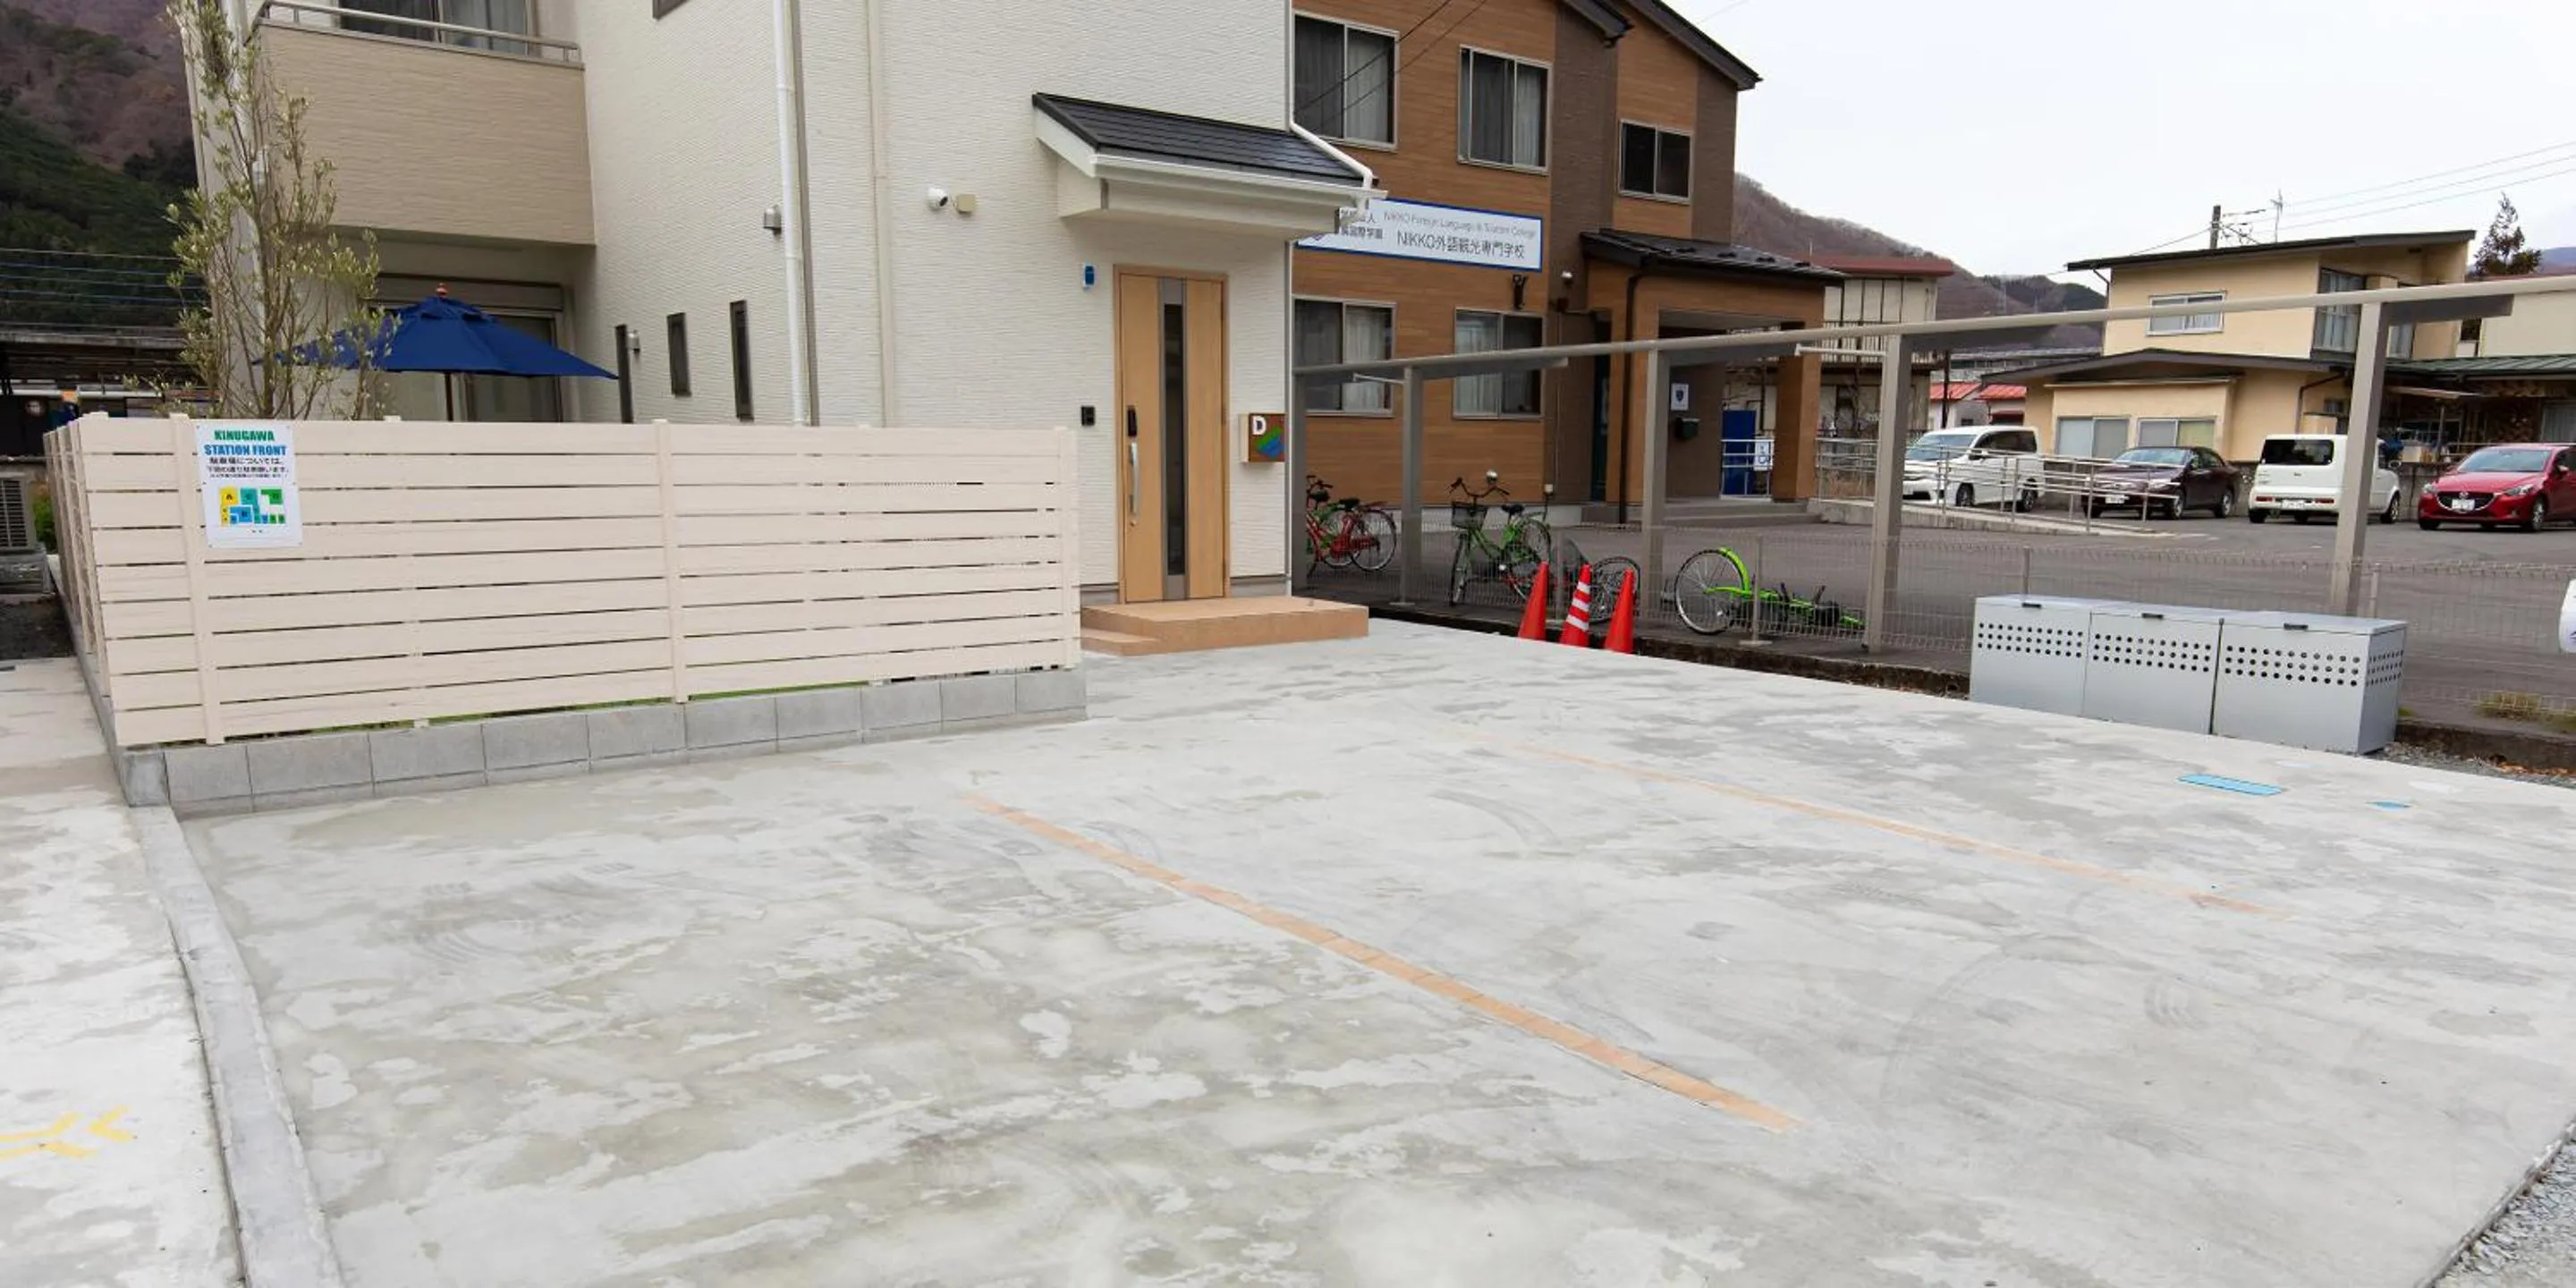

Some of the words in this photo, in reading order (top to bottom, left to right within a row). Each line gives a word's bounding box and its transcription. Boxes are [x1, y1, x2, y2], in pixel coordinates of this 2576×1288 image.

[1252, 415, 1267, 436] D
[214, 430, 275, 441] KINUGAWA
[204, 444, 250, 455] STATION
[252, 445, 287, 455] FRONT
